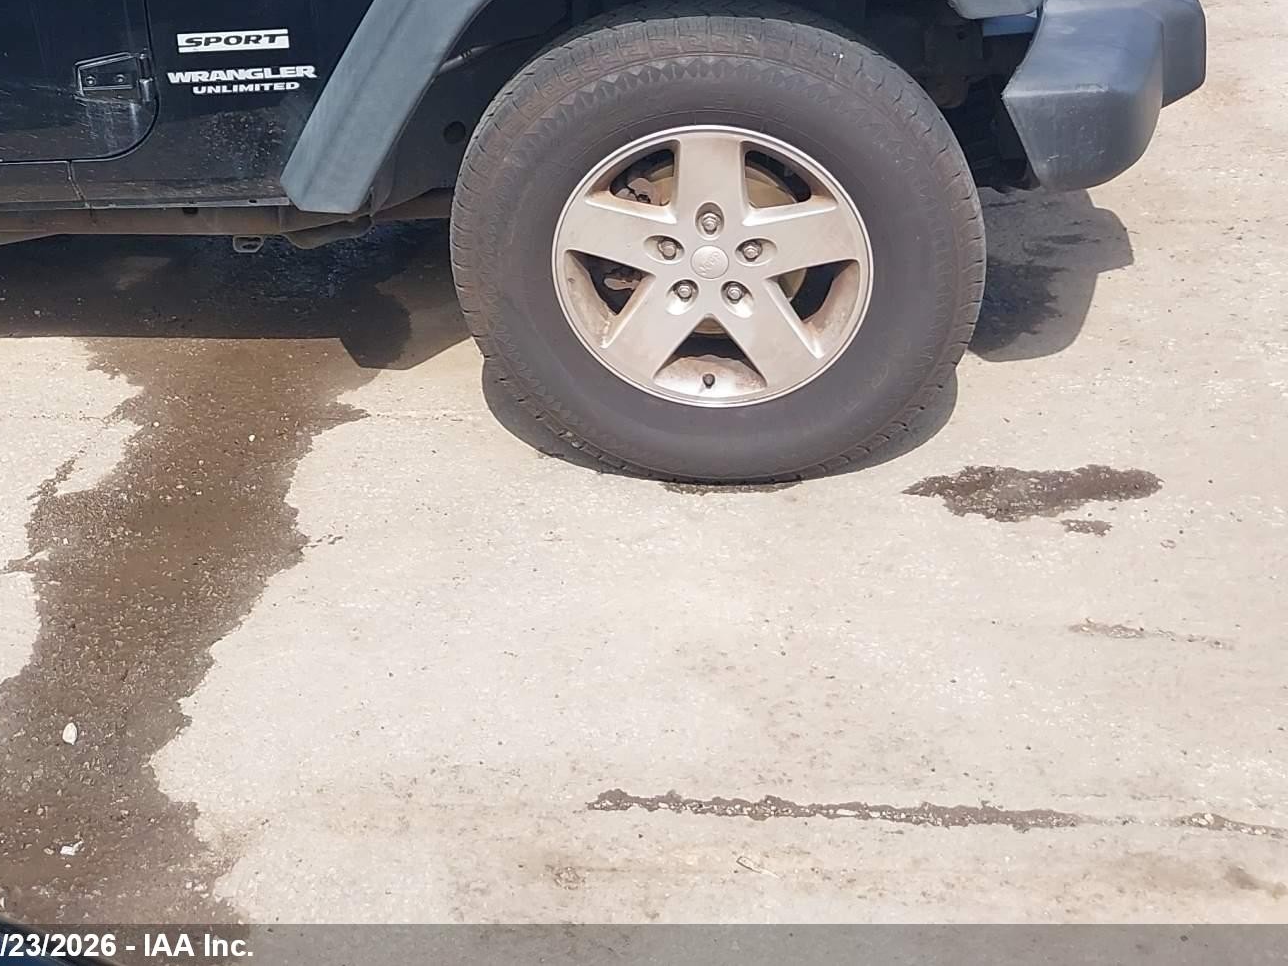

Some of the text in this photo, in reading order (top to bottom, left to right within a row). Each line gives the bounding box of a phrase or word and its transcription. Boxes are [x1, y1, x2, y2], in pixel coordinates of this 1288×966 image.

[178, 33, 288, 49] SPORT
[167, 65, 317, 84] WRANGLER
[192, 81, 300, 95] UNLIMITED
